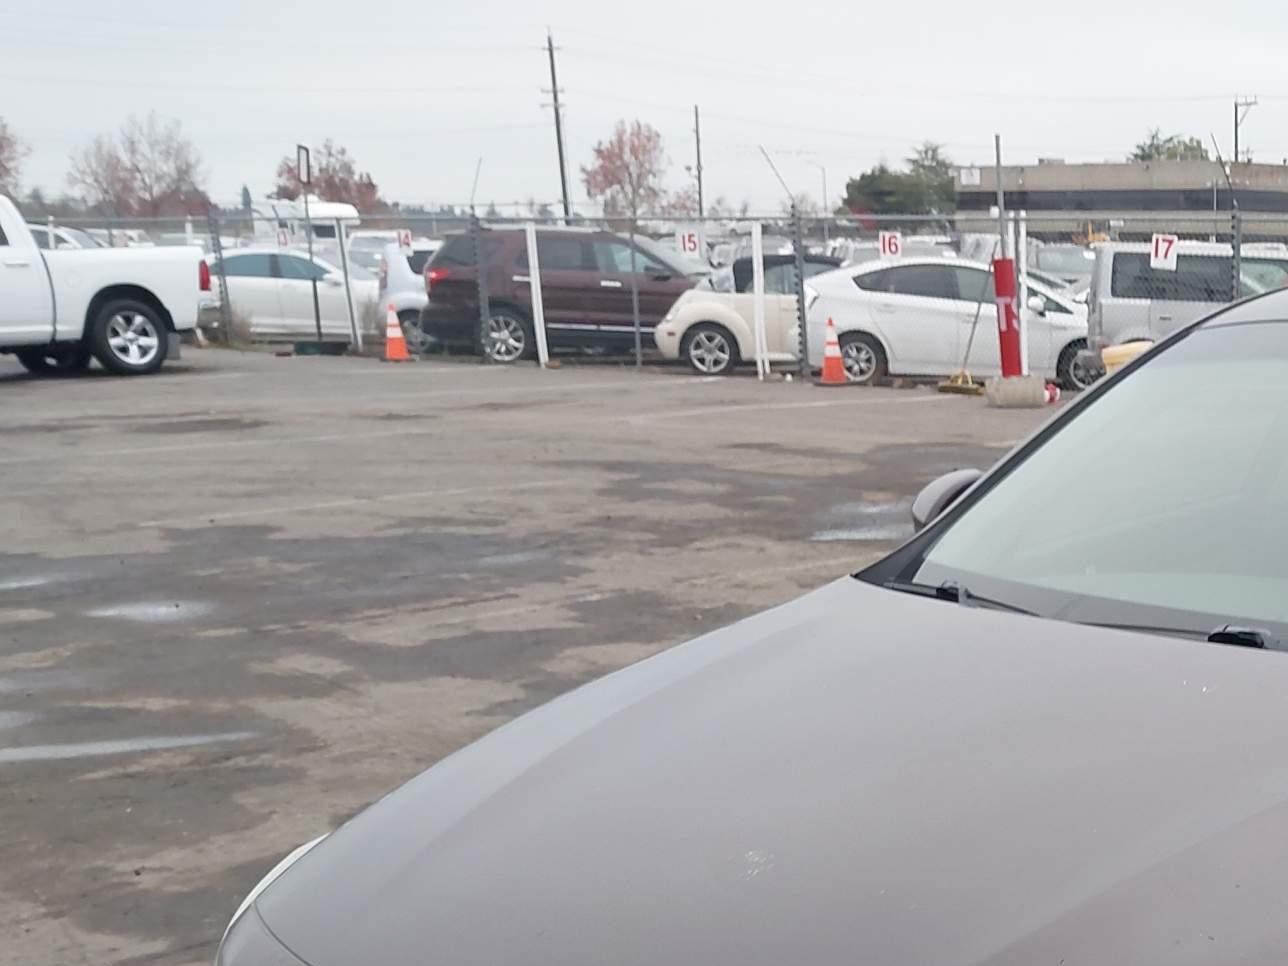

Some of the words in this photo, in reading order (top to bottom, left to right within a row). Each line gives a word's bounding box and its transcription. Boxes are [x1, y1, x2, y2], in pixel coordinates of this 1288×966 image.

[682, 234, 698, 252] 15
[882, 234, 899, 255] 16
[1154, 238, 1175, 259] 17
